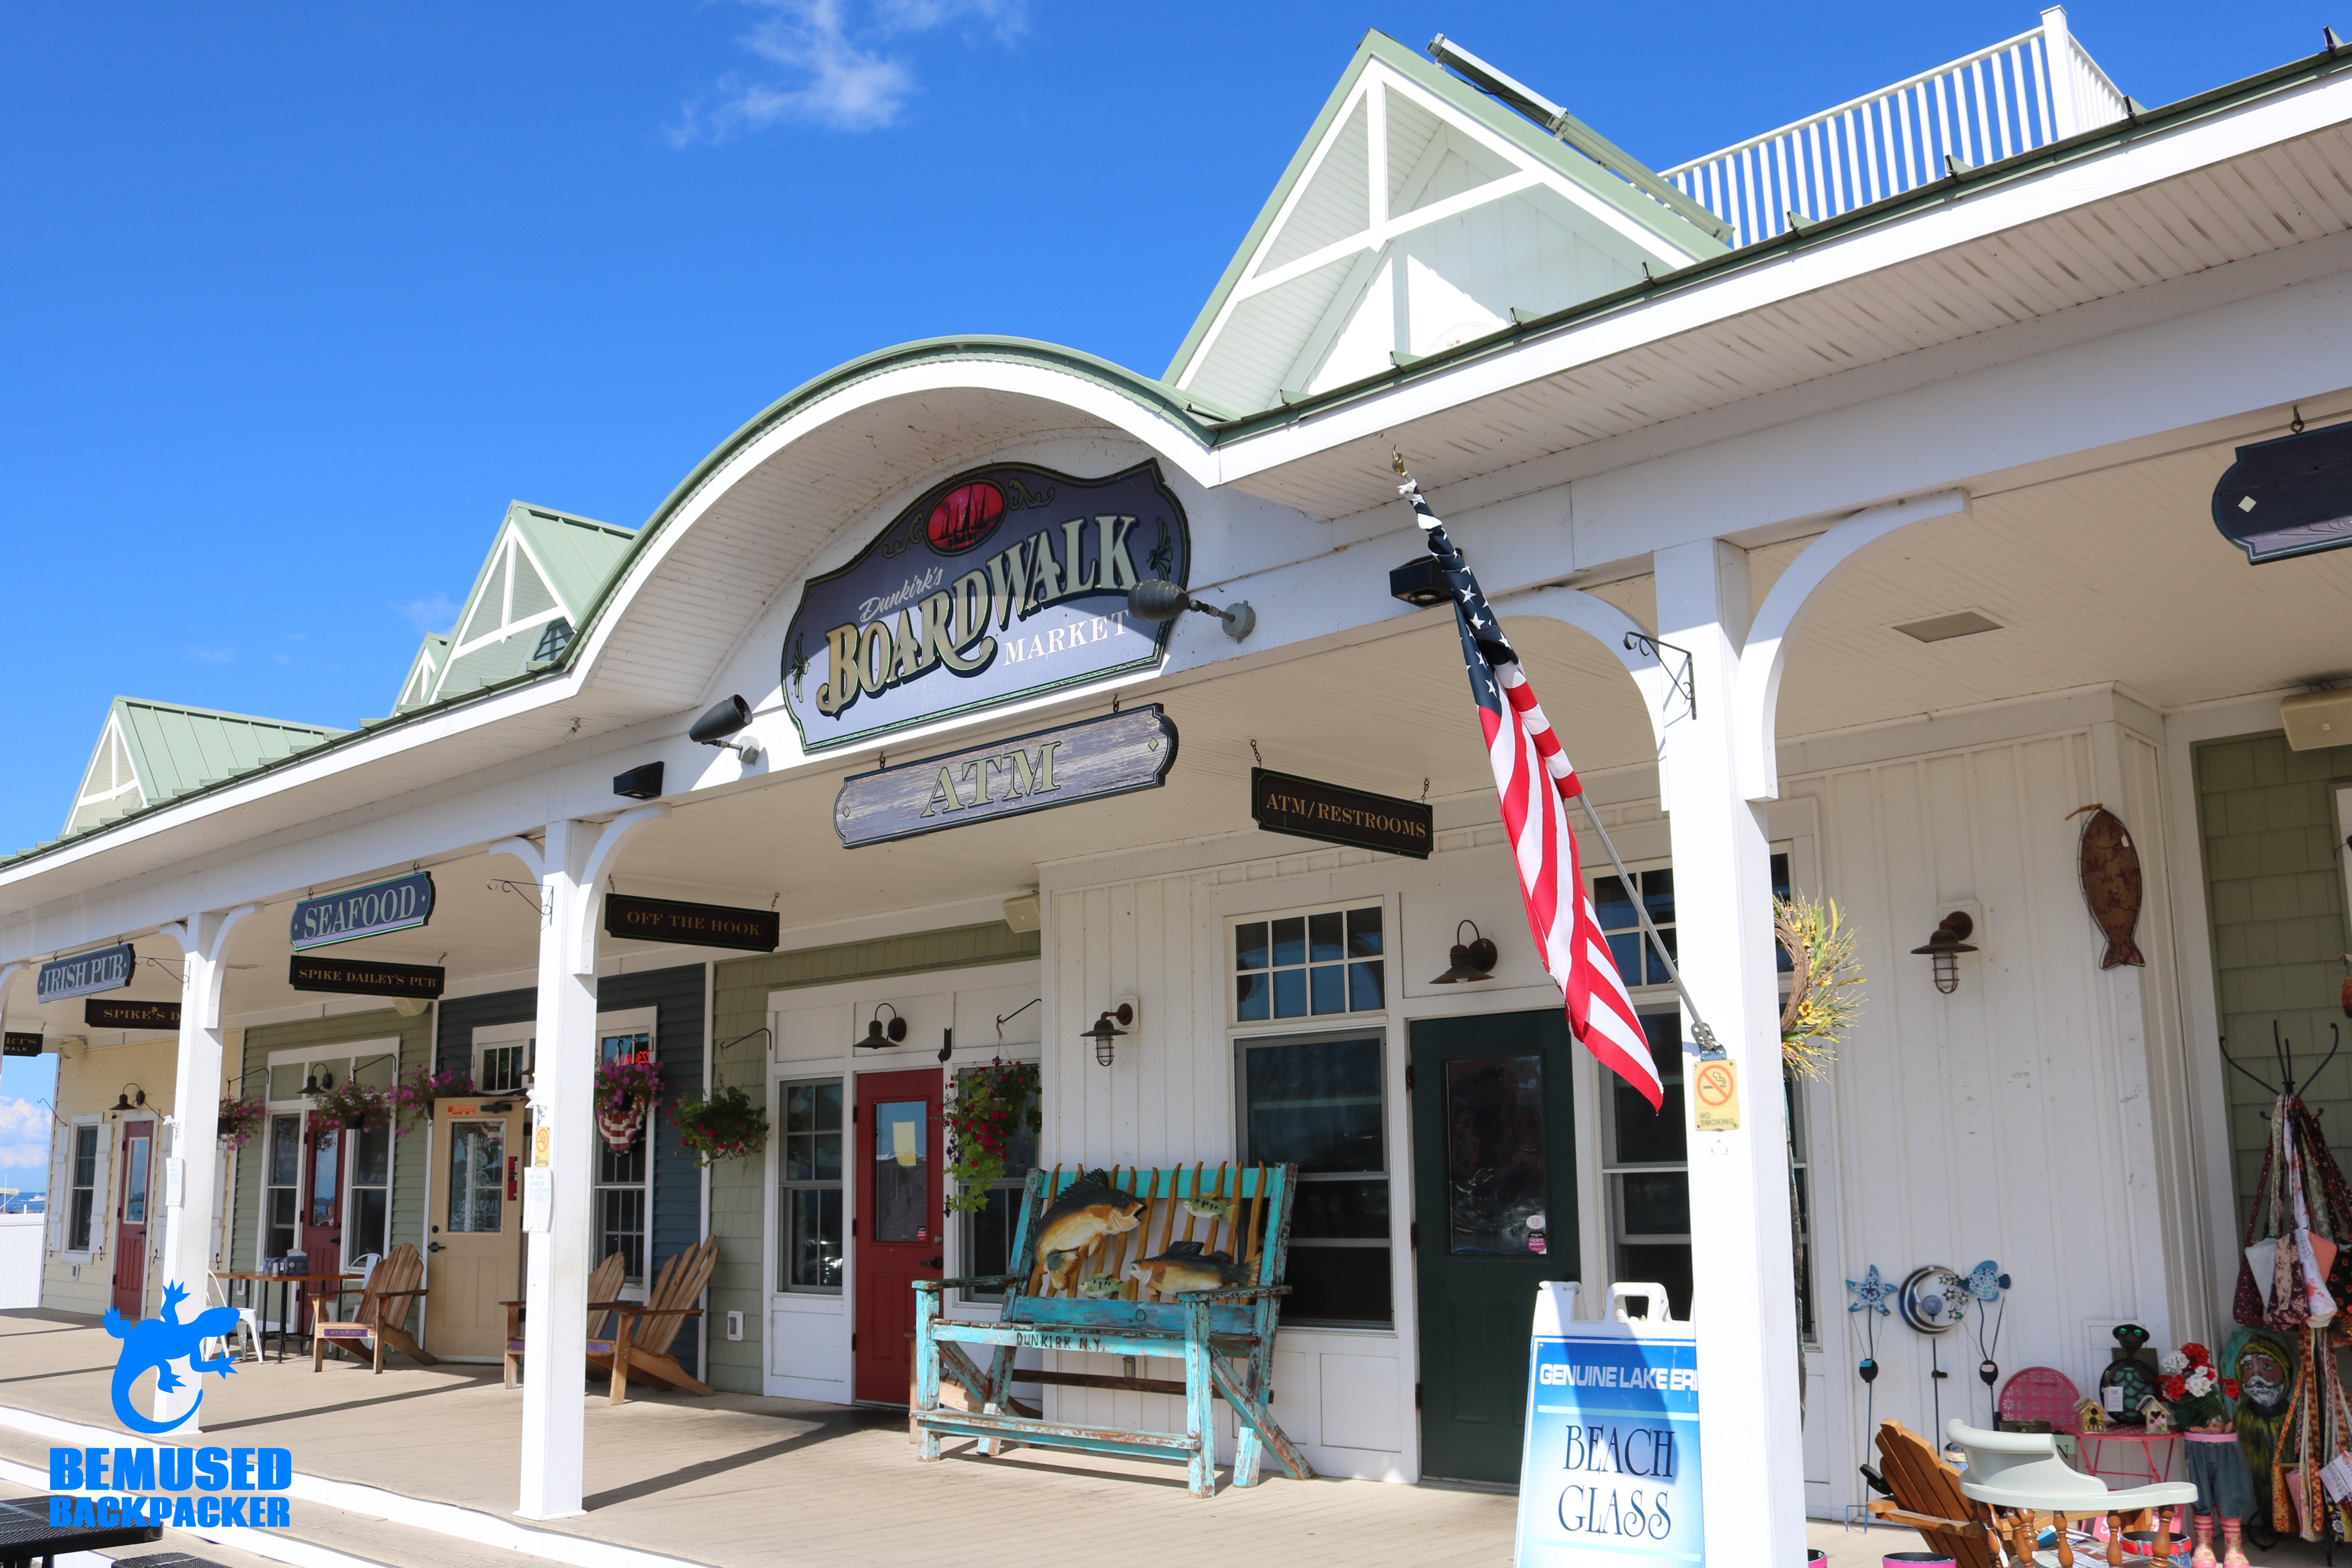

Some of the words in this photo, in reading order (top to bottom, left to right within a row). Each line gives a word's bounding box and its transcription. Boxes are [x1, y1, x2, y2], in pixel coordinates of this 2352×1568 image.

[816, 514, 1139, 717] BOARDWALK
[858, 566, 944, 622] Dunkirk's
[1003, 609, 1129, 666] MARKET
[920, 741, 1062, 818] ATM
[1266, 793, 1426, 838] ATM/RESTROOMS
[304, 885, 416, 940] SEAFOOD
[627, 911, 663, 925] OFF
[669, 915, 704, 929] THE
[711, 920, 760, 936] HOOK
[43, 960, 89, 995] IRISH
[91, 953, 123, 986] PUB
[299, 969, 341, 981] SPIKE
[347, 972, 405, 985] DAILEY'S
[410, 976, 436, 987] PUB
[1700, 1118, 1735, 1126] SMOKING
[1016, 1332, 1071, 1349] DUNKIRK
[1080, 1336, 1105, 1353] N.Y.
[1539, 1363, 1618, 1388] GENUINE
[1619, 1367, 1668, 1390] LAKE
[1563, 1424, 1675, 1477] BEACH
[1558, 1485, 1671, 1540] GLASS
